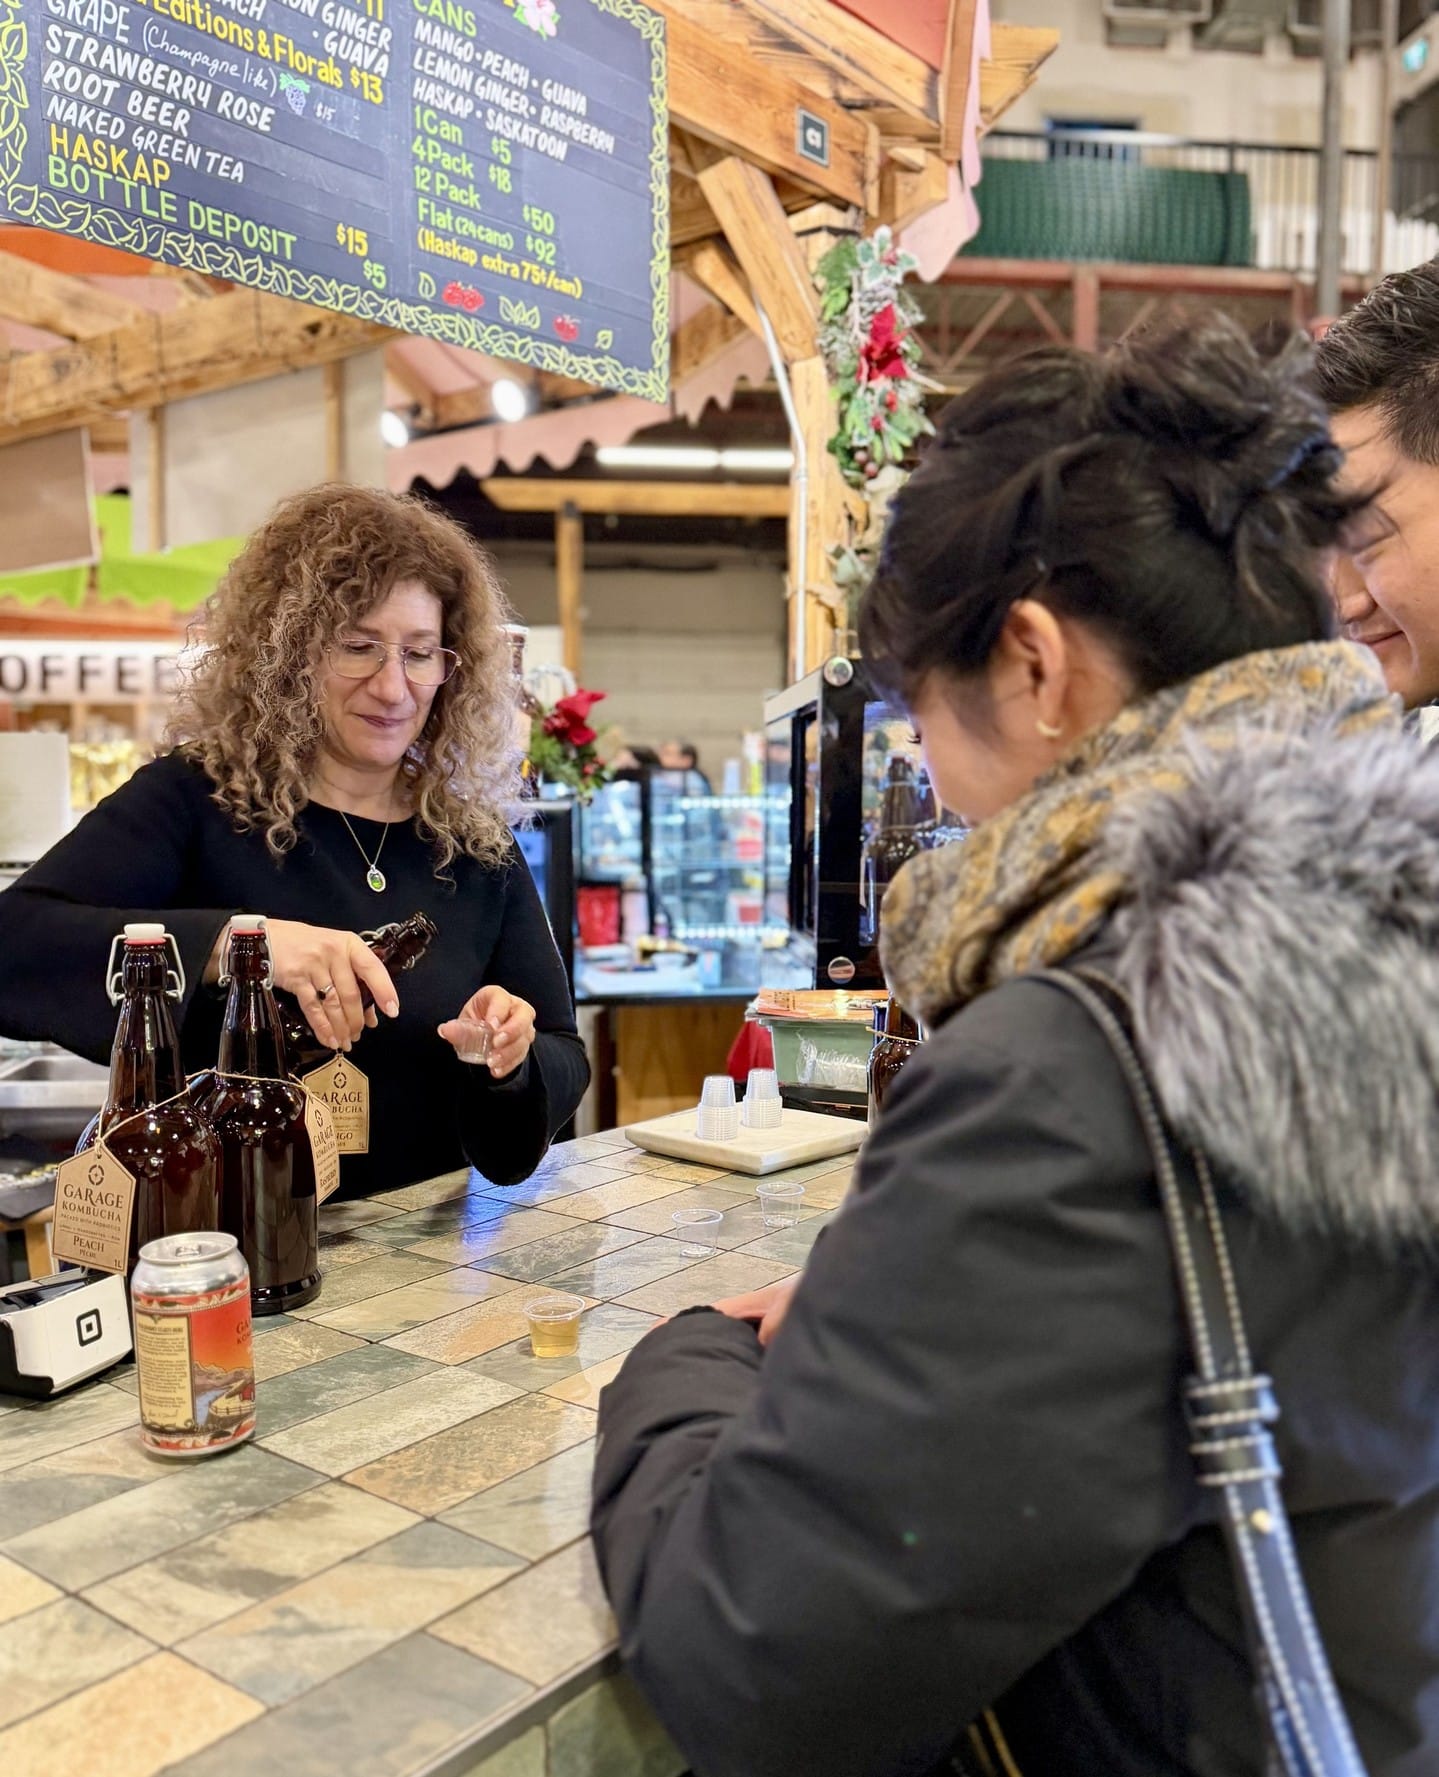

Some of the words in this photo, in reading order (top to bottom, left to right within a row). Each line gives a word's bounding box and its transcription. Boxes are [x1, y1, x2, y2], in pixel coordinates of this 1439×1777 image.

[48, 0, 130, 43] GRAPE
[322, 2, 392, 52] GINGER
[324, 31, 389, 78] GUAVA
[414, 18, 474, 63] MANGO
[482, 50, 530, 89] PEACH
[542, 79, 587, 116] GUAVA
[43, 60, 120, 106] ROOT
[127, 90, 191, 137] BEER
[45, 24, 212, 108] STRAWBERRY
[217, 90, 275, 131] ROSE
[351, 67, 383, 104] $13
[413, 47, 474, 92] LEMON
[474, 76, 530, 119] GINGER
[540, 105, 615, 154] RASPBERRY
[413, 77, 474, 119] HASKAP
[486, 108, 568, 161] SASKATOON
[47, 95, 125, 139] NAKED
[132, 126, 201, 169] GREEN
[205, 152, 244, 183] TEA
[492, 137, 511, 165] $5
[51, 123, 170, 188] HASKAP
[336, 222, 368, 257] $15
[436, 172, 481, 210] Pack
[489, 164, 512, 193] $18
[48, 154, 177, 222] BOTTLE
[189, 200, 297, 260] DEPOSIT
[363, 259, 386, 289] $5
[523, 204, 555, 235] $50
[417, 227, 478, 267] (Haskap
[482, 253, 519, 279] extra
[526, 234, 556, 266] $92
[310, 1091, 364, 1106] ARAGE
[62, 1200, 122, 1222] KOMBUCHA
[64, 1184, 124, 1209] GARAGE
[73, 1235, 104, 1252] PEACH
